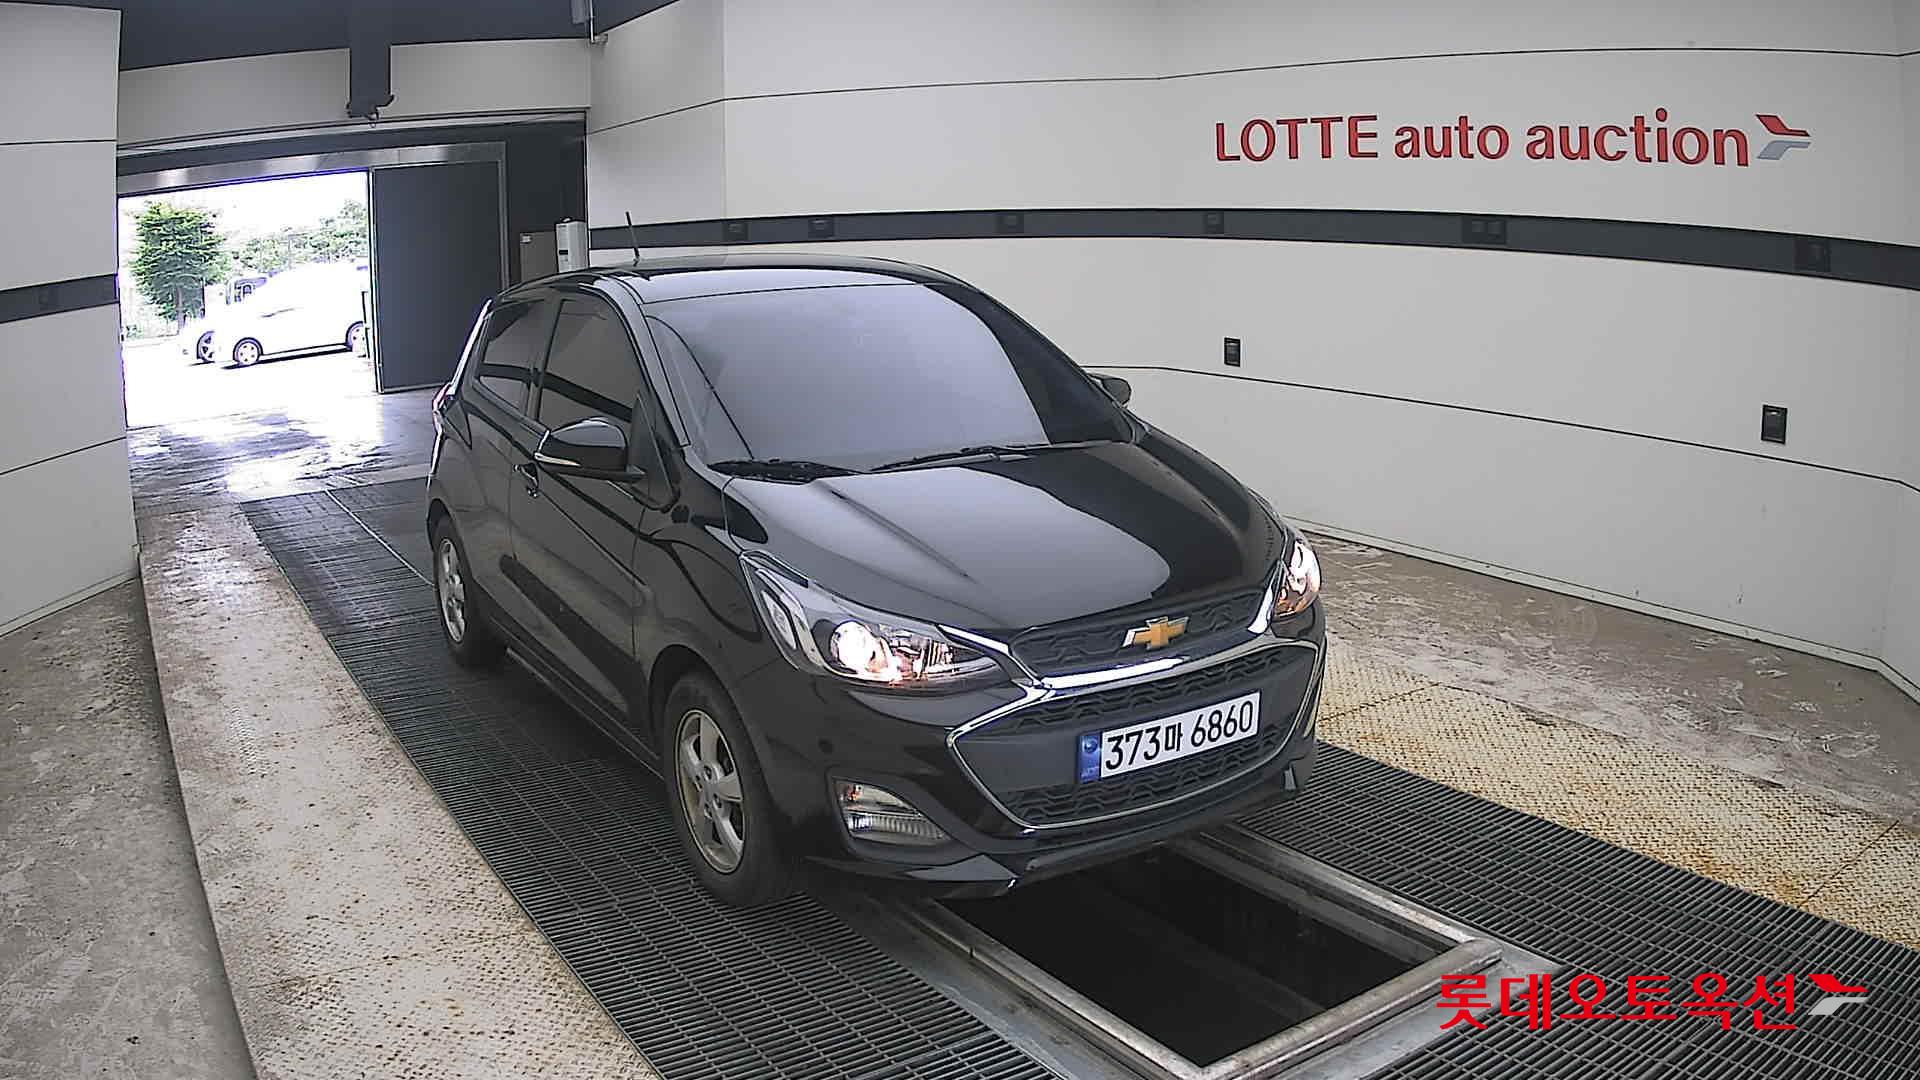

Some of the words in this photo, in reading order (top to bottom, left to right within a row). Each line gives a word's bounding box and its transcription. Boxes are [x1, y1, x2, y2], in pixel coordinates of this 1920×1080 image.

[1215, 114, 1378, 162] LOTTE
[1394, 115, 1510, 161] auto
[1525, 107, 1750, 167] auction
[1105, 722, 1183, 770] 373마
[1190, 701, 1253, 748] 6860
